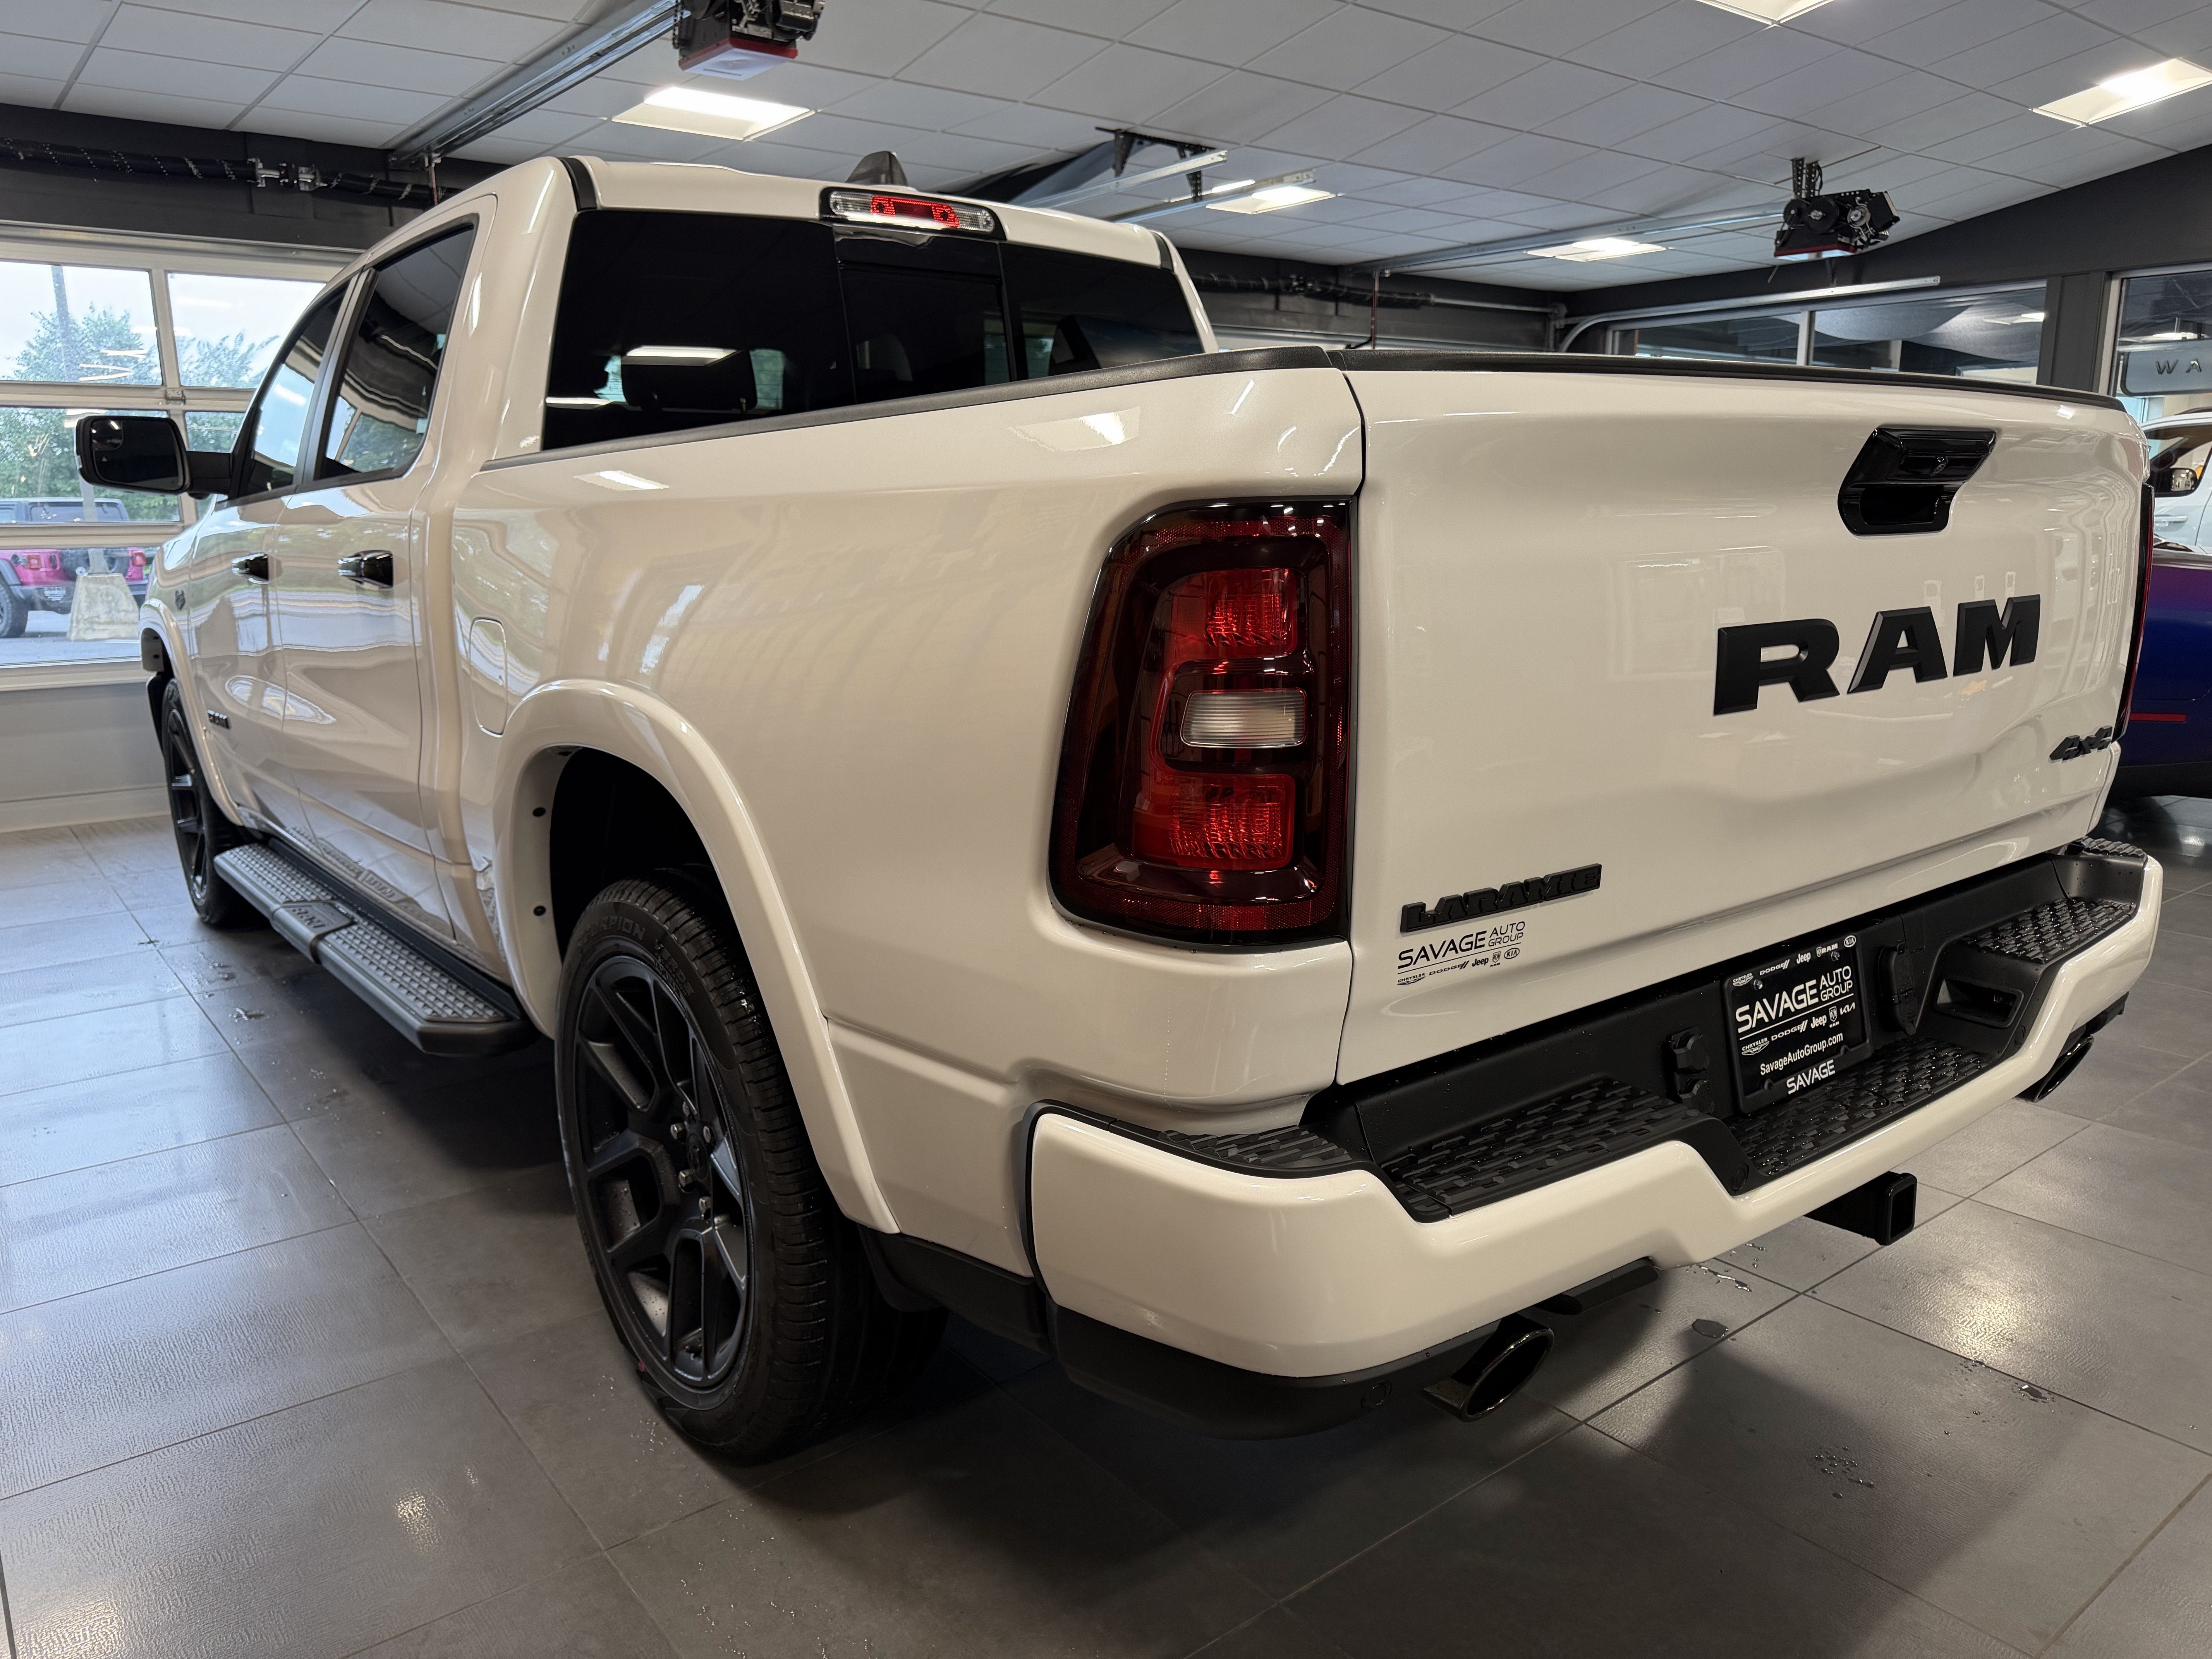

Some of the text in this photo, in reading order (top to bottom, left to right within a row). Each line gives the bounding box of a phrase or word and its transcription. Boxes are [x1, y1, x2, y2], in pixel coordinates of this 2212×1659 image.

[1714, 594, 2040, 716] RAM
[1400, 863, 1602, 932] LARAMIE
[577, 915, 646, 948] CORPION
[1398, 921, 1525, 969] SAVAGE AUTO
[1488, 932, 1523, 947] GROUP
[1398, 973, 1425, 983] CHRYSLER
[1429, 963, 1465, 975] DODGE
[1472, 957, 1489, 967] Jeep
[1733, 972, 1752, 983] CHRYSLER
[1759, 962, 1786, 975] DODGE
[1796, 952, 1811, 964] Jeep
[1822, 943, 1838, 954] RAM
[1736, 965, 1851, 1033] SAVAGE AUTO
[1820, 980, 1853, 1002] GROUP
[1742, 1037, 1768, 1051] CHRYSLER
[1771, 1024, 1802, 1041] DODGE
[1811, 1015, 1827, 1029] Jeep
[1760, 1033, 1843, 1075] SavageAutoGroup.com
[1786, 1060, 1836, 1095] SAVAGE
